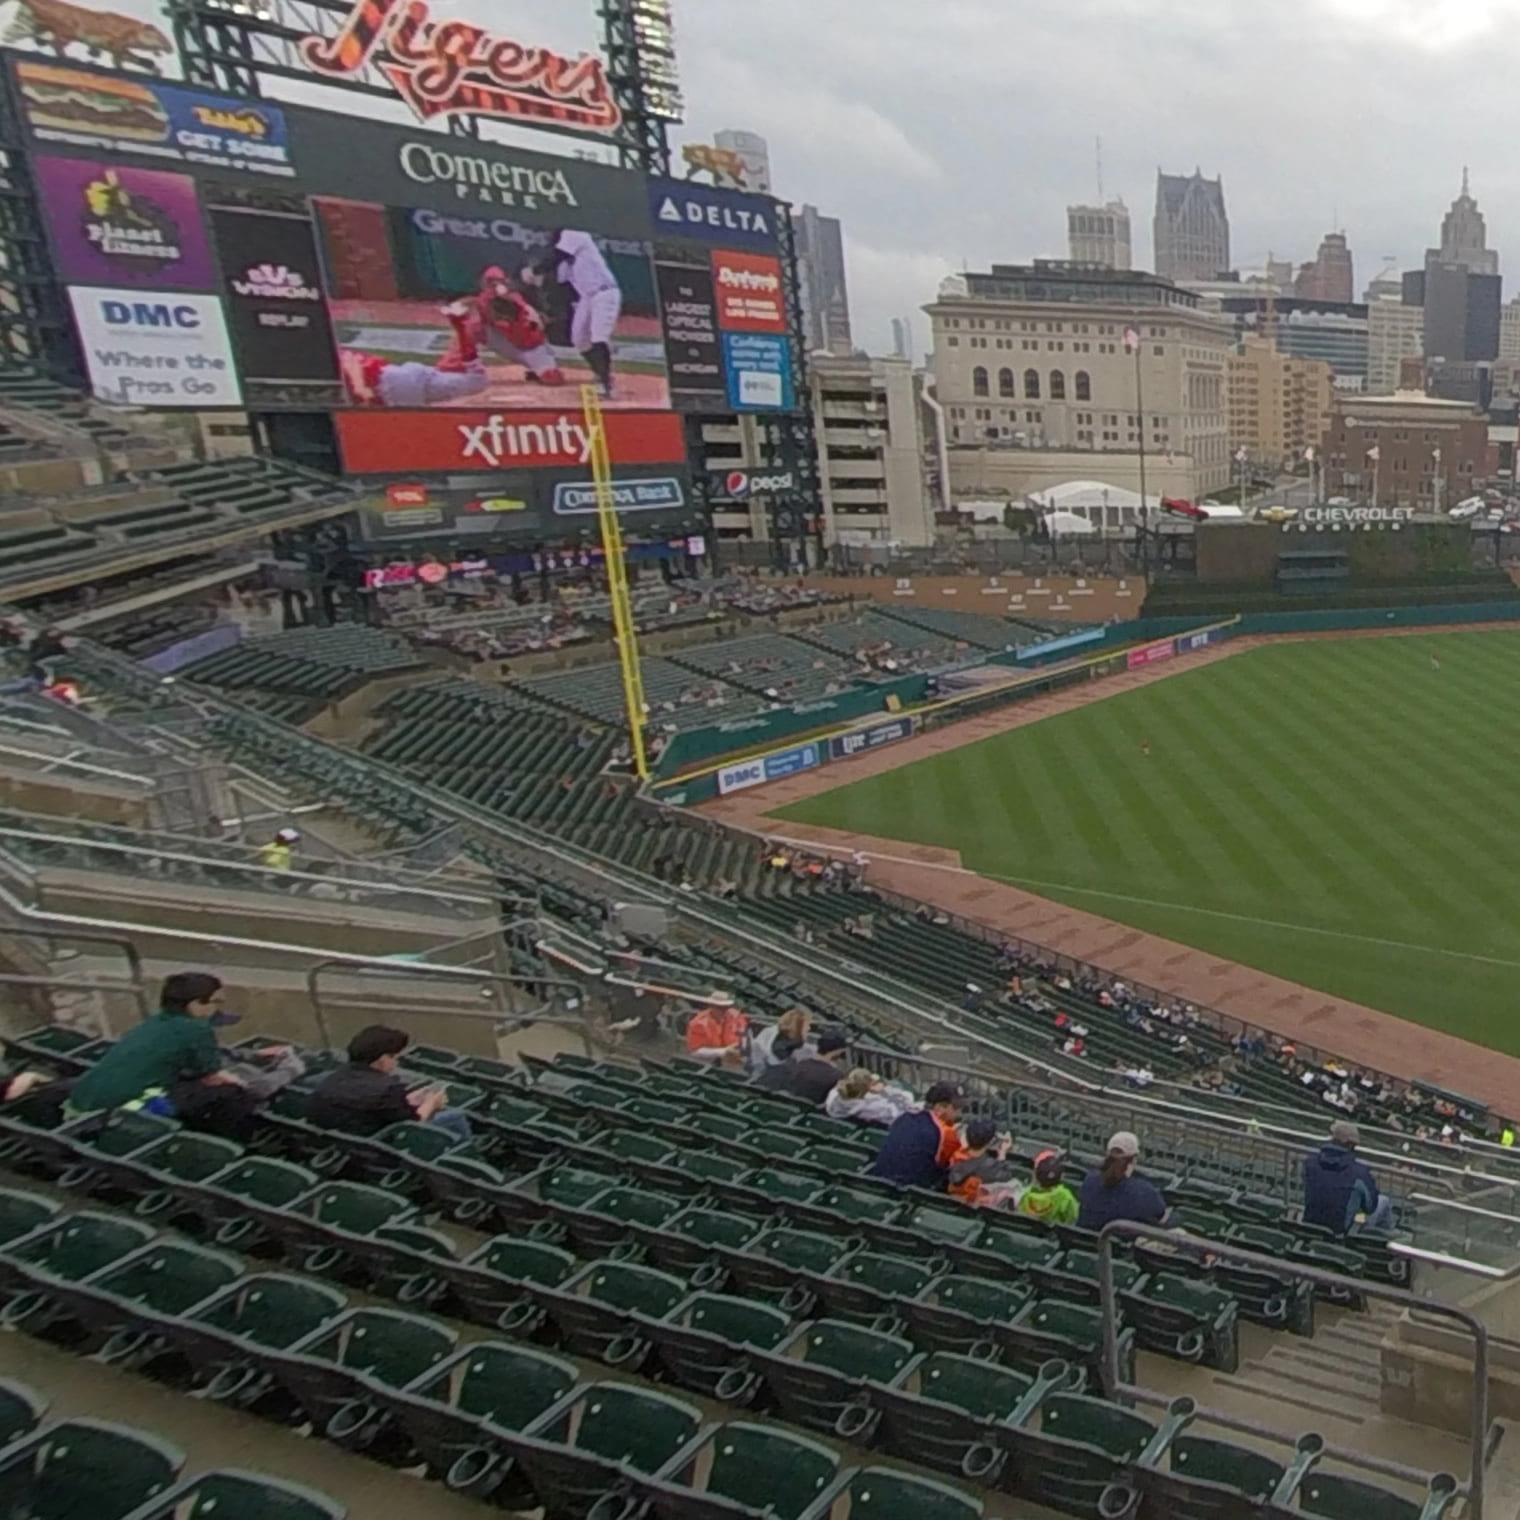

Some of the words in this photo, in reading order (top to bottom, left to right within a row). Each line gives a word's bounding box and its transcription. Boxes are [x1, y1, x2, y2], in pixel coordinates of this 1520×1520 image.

[300, 0, 618, 116] Tigers
[177, 129, 222, 151] GET
[411, 208, 489, 240] Great
[491, 218, 550, 249] Clips
[686, 200, 769, 235] DELTA
[231, 280, 320, 301] VISION
[100, 300, 201, 329] DMC
[94, 349, 179, 371] Where
[184, 351, 226, 371] the
[117, 375, 175, 396] Pros
[180, 376, 217, 396] Go
[458, 415, 600, 466] xfinity
[636, 483, 673, 502] Bank
[750, 471, 793, 493] pepsi
[1303, 506, 1415, 522] CHEVROLET
[723, 765, 761, 788] DMC
